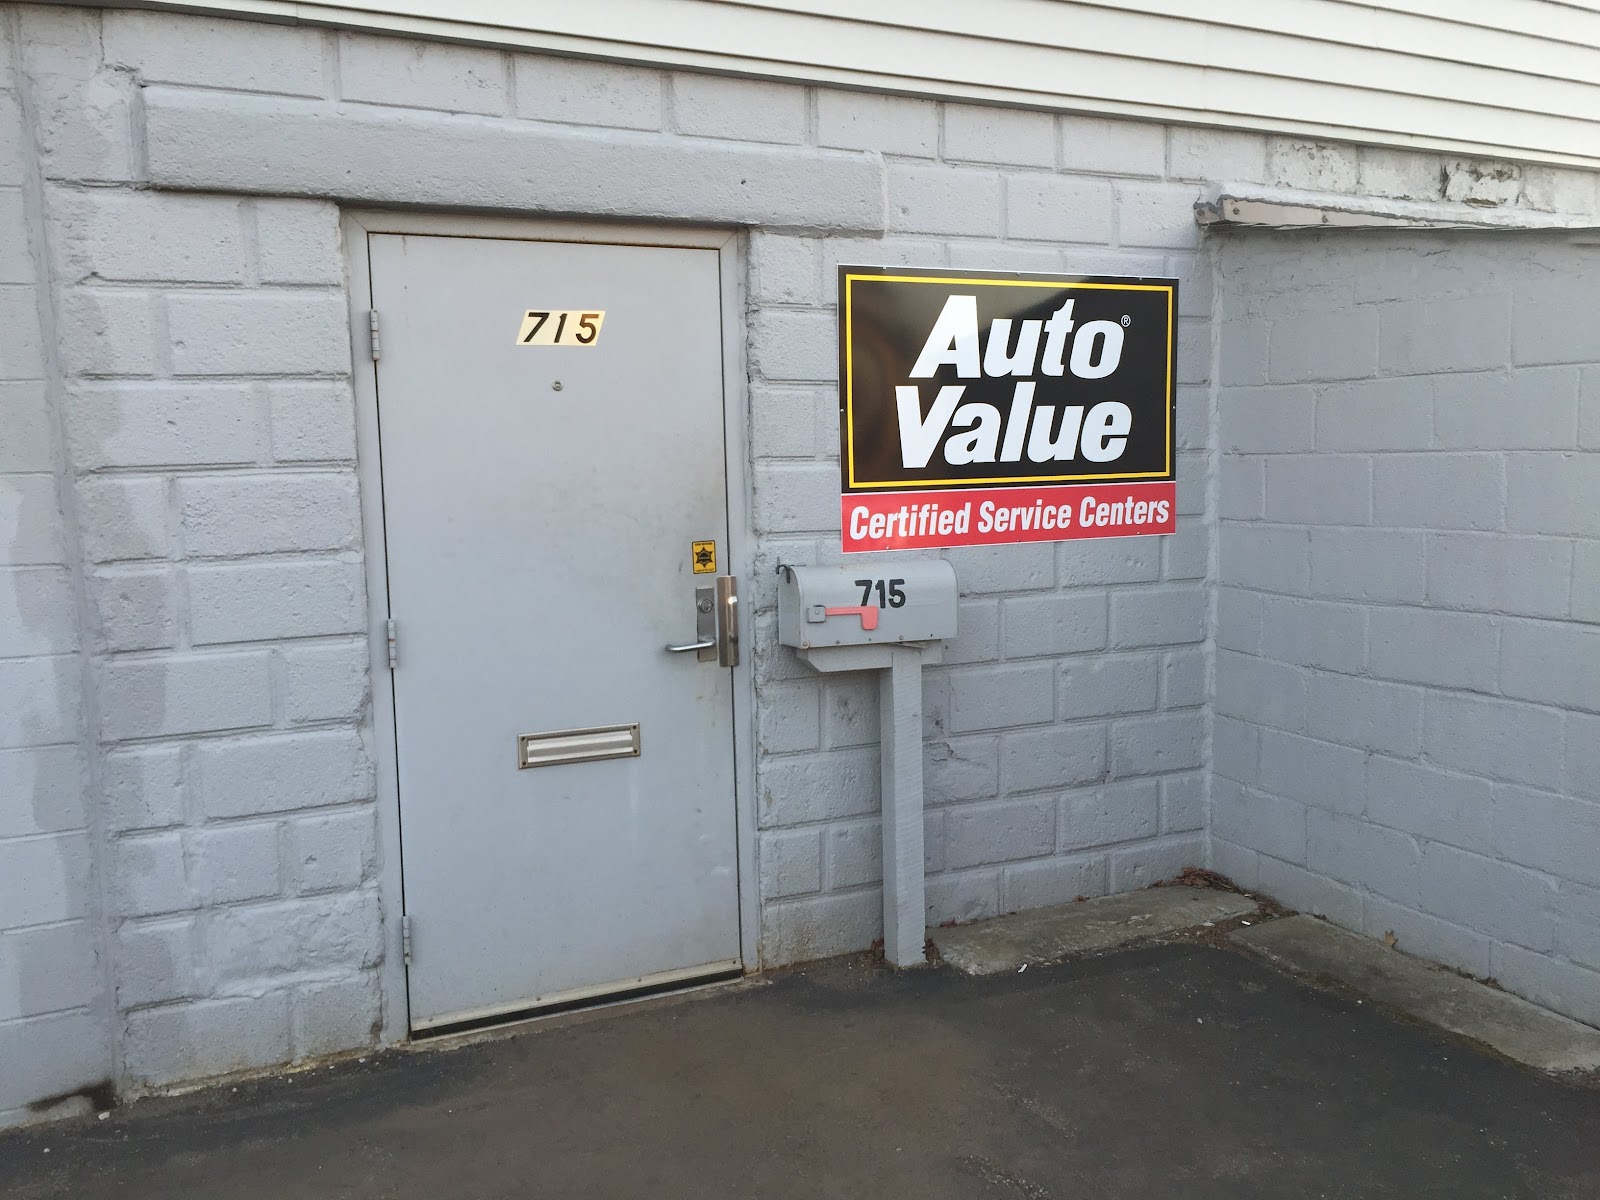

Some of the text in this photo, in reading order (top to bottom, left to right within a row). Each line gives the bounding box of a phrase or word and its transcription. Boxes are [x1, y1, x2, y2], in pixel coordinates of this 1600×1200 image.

[523, 312, 600, 344] 715
[895, 381, 1133, 469] Value
[850, 496, 1170, 540] Certified Service Centers
[854, 578, 907, 609] 715
